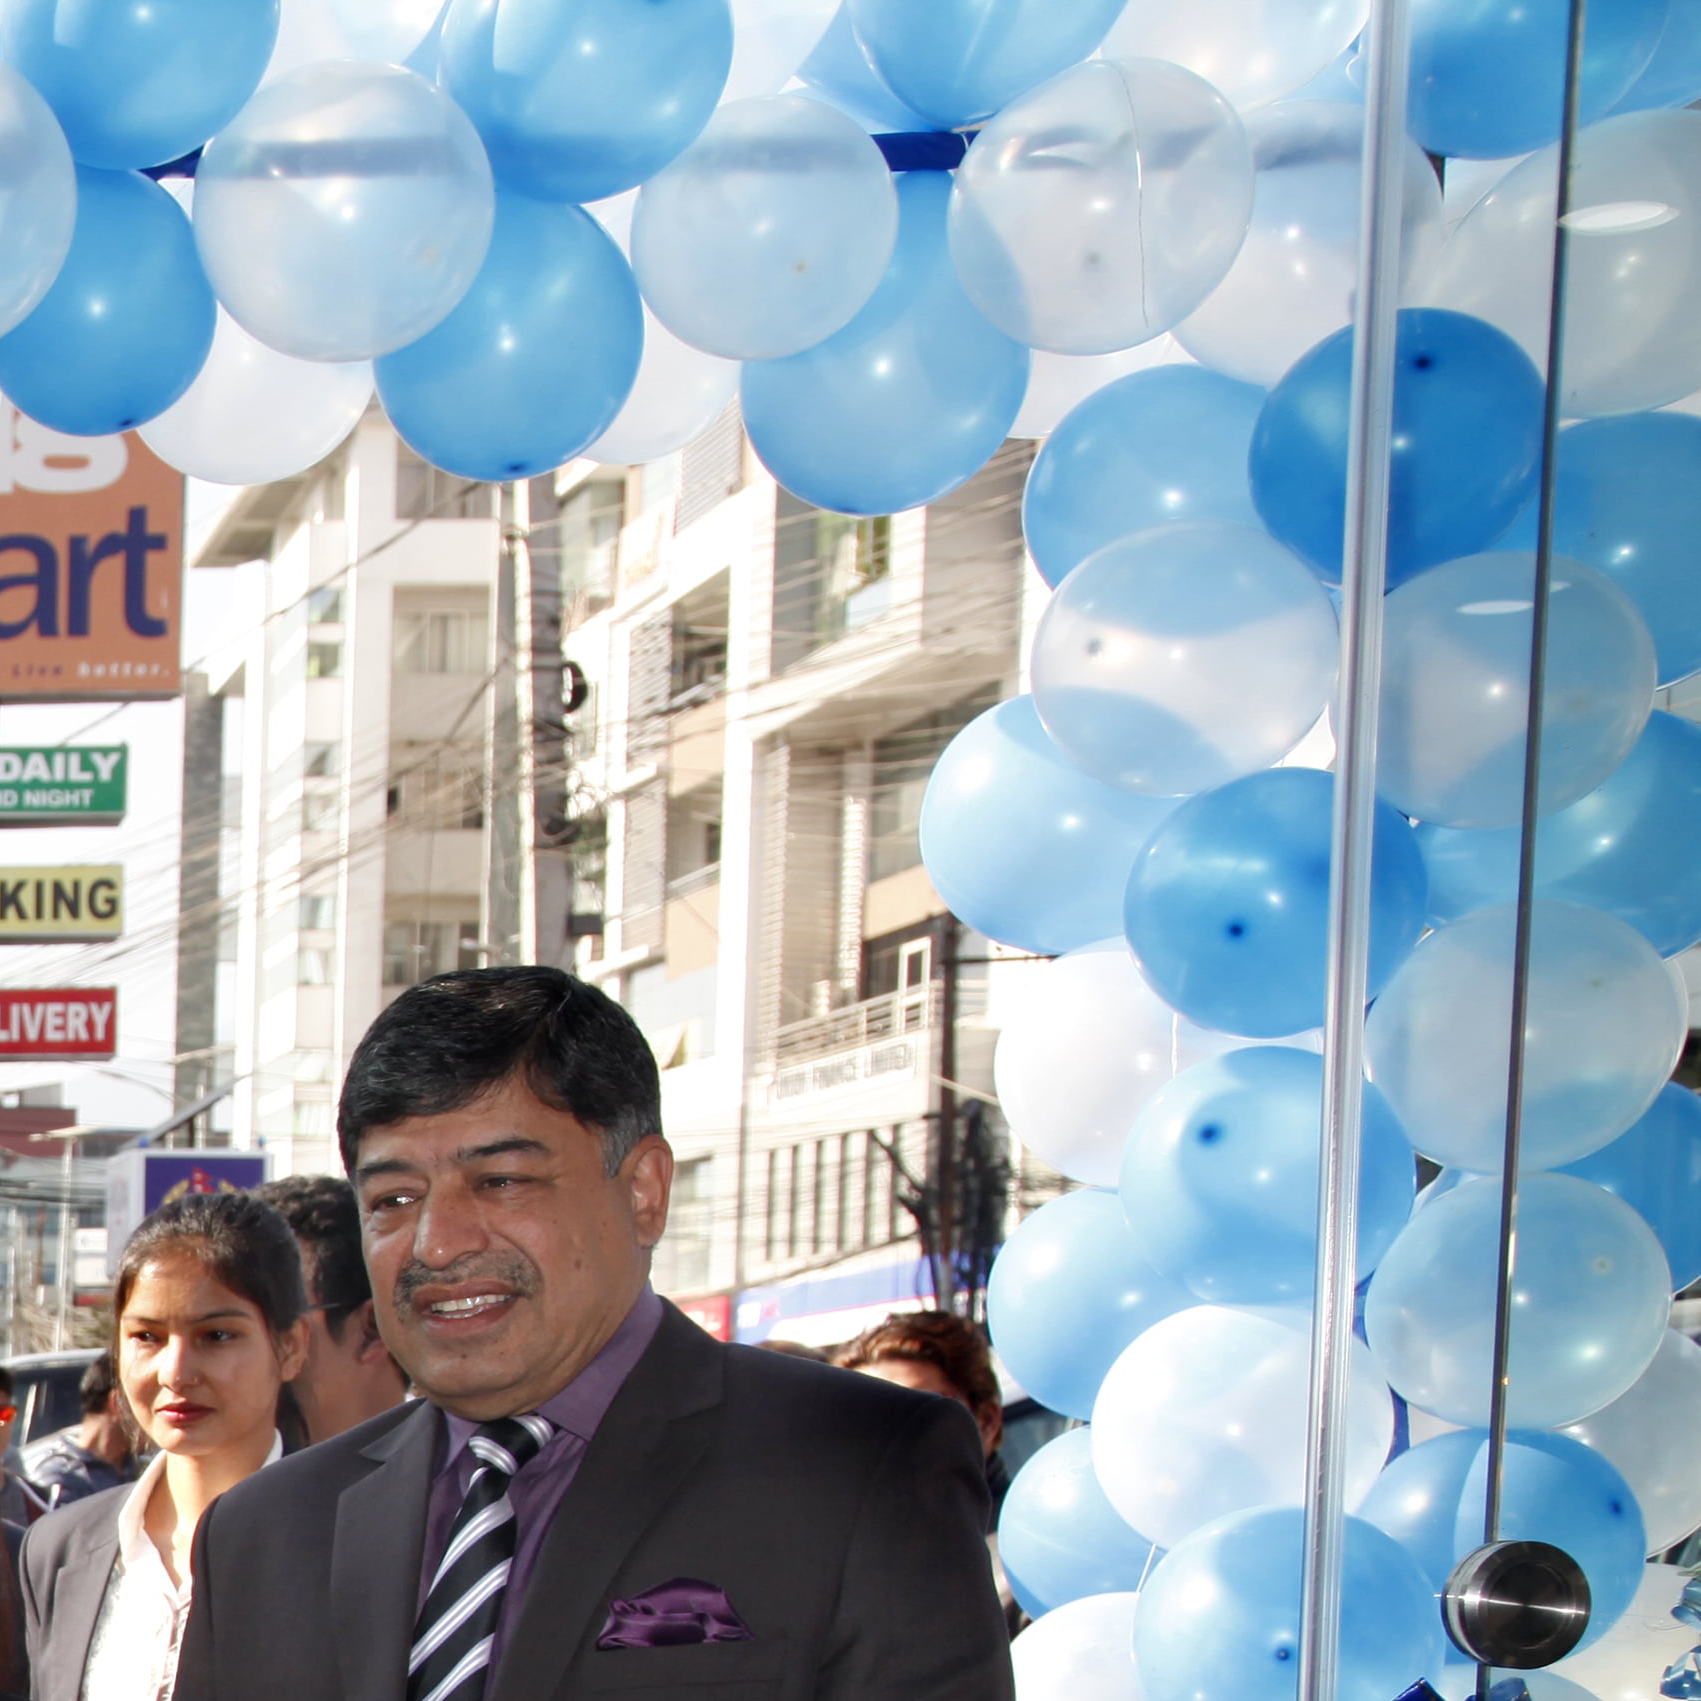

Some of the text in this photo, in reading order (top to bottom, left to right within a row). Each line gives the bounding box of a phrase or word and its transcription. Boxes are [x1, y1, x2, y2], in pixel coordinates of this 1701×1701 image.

[11, 663, 64, 678] Live
[77, 661, 171, 679] better.
[23, 788, 95, 807] NIGHT
